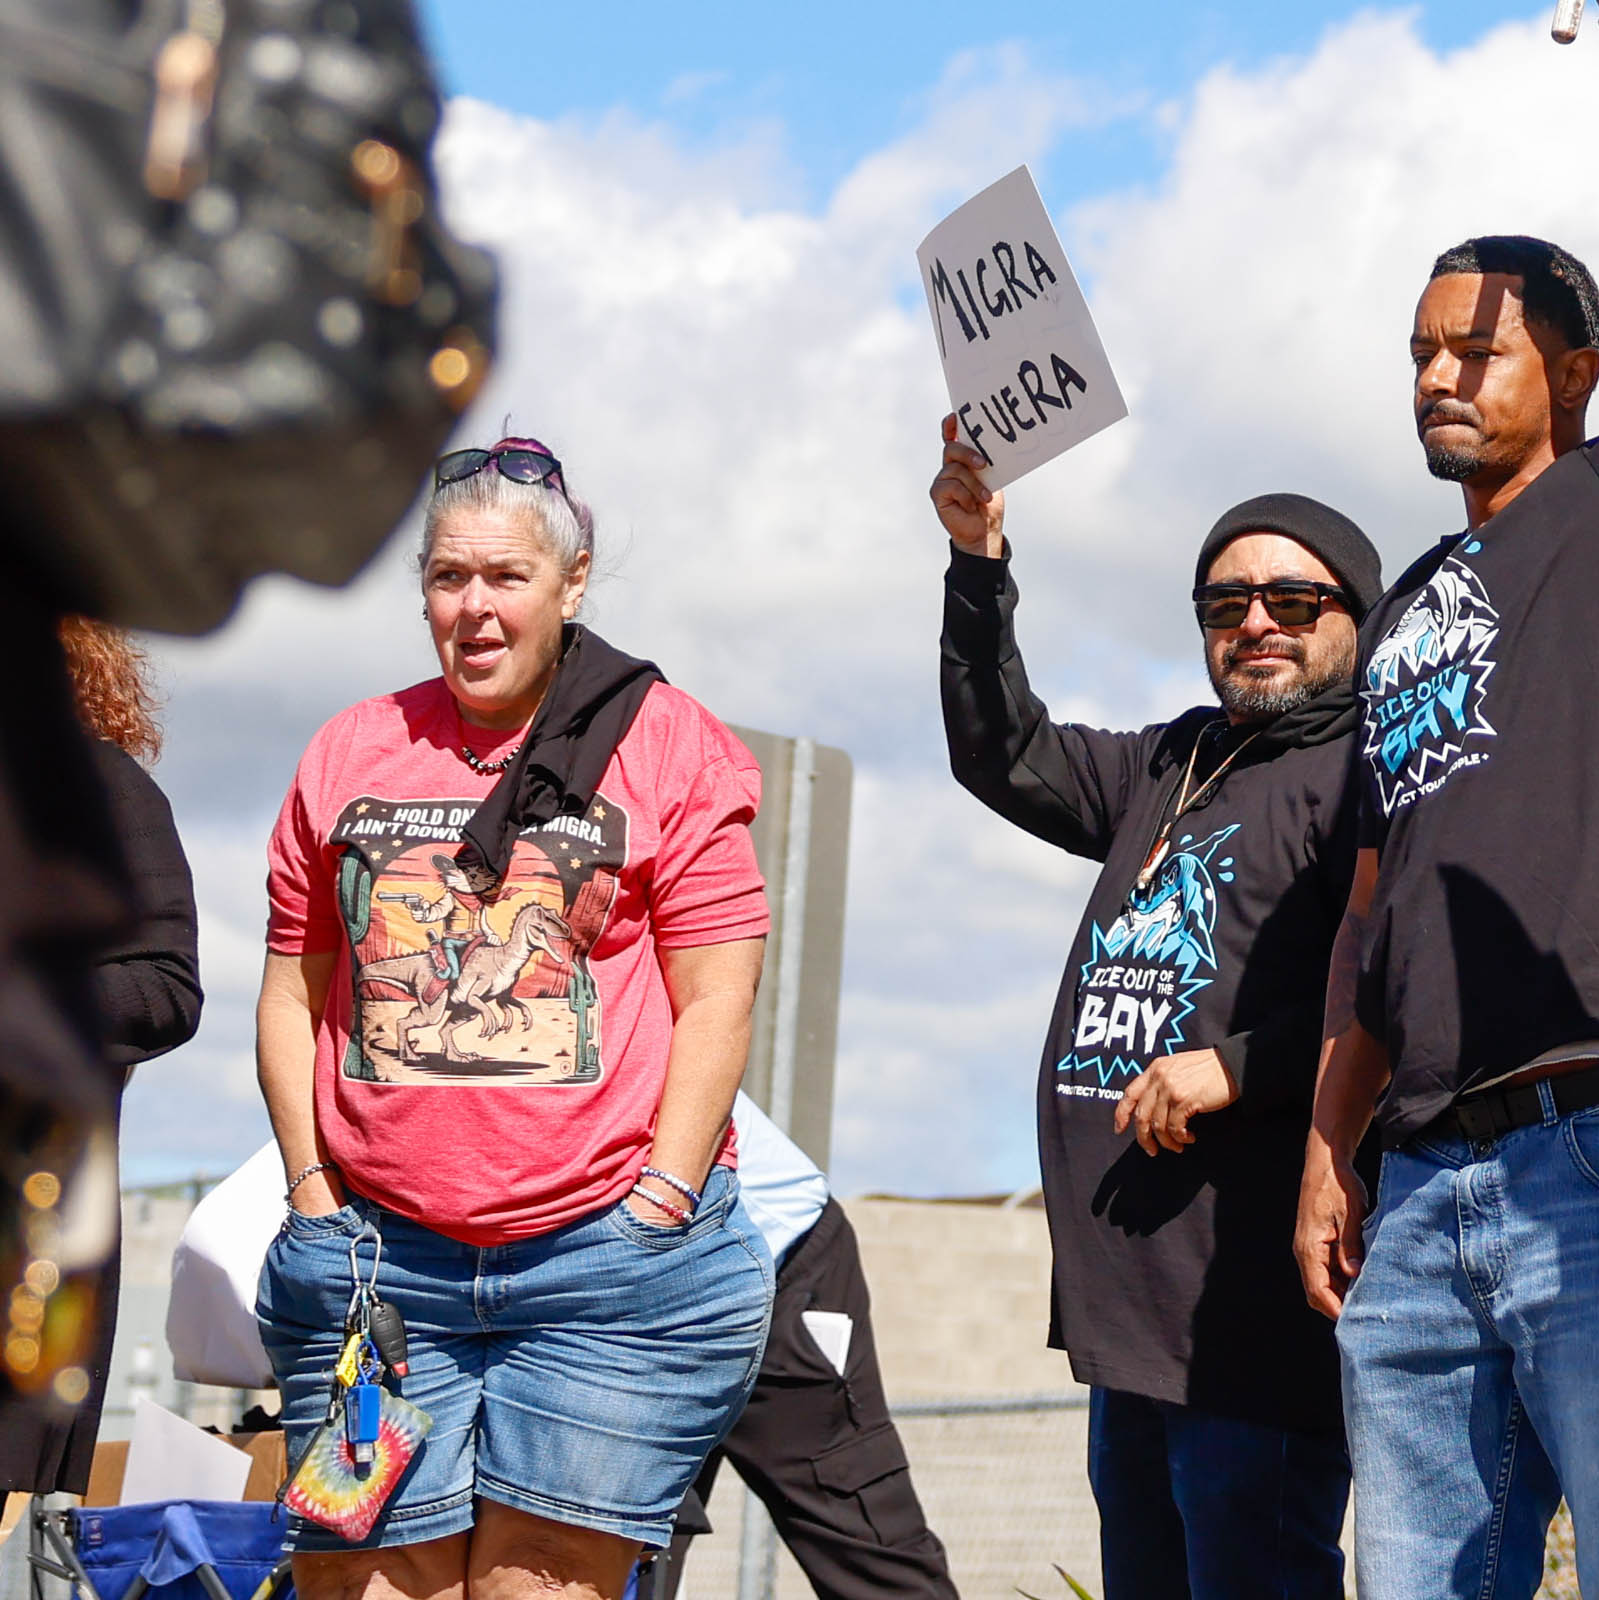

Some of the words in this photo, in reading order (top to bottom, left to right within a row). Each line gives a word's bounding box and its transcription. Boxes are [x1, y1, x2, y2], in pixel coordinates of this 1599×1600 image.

[930, 241, 1057, 358] MIGRA
[959, 353, 1087, 466] FUERA
[1376, 689, 1416, 728] ICE
[1417, 666, 1455, 701] OUT
[341, 823, 351, 837] I
[351, 819, 403, 835] AIN'T
[393, 808, 445, 825] HOLD
[543, 815, 607, 847] MIGRA.
[1088, 966, 1124, 988] ICE
[1123, 968, 1158, 990] OUT
[1159, 969, 1175, 983] OF
[1157, 983, 1175, 995] THE
[1075, 993, 1173, 1055] BAY
